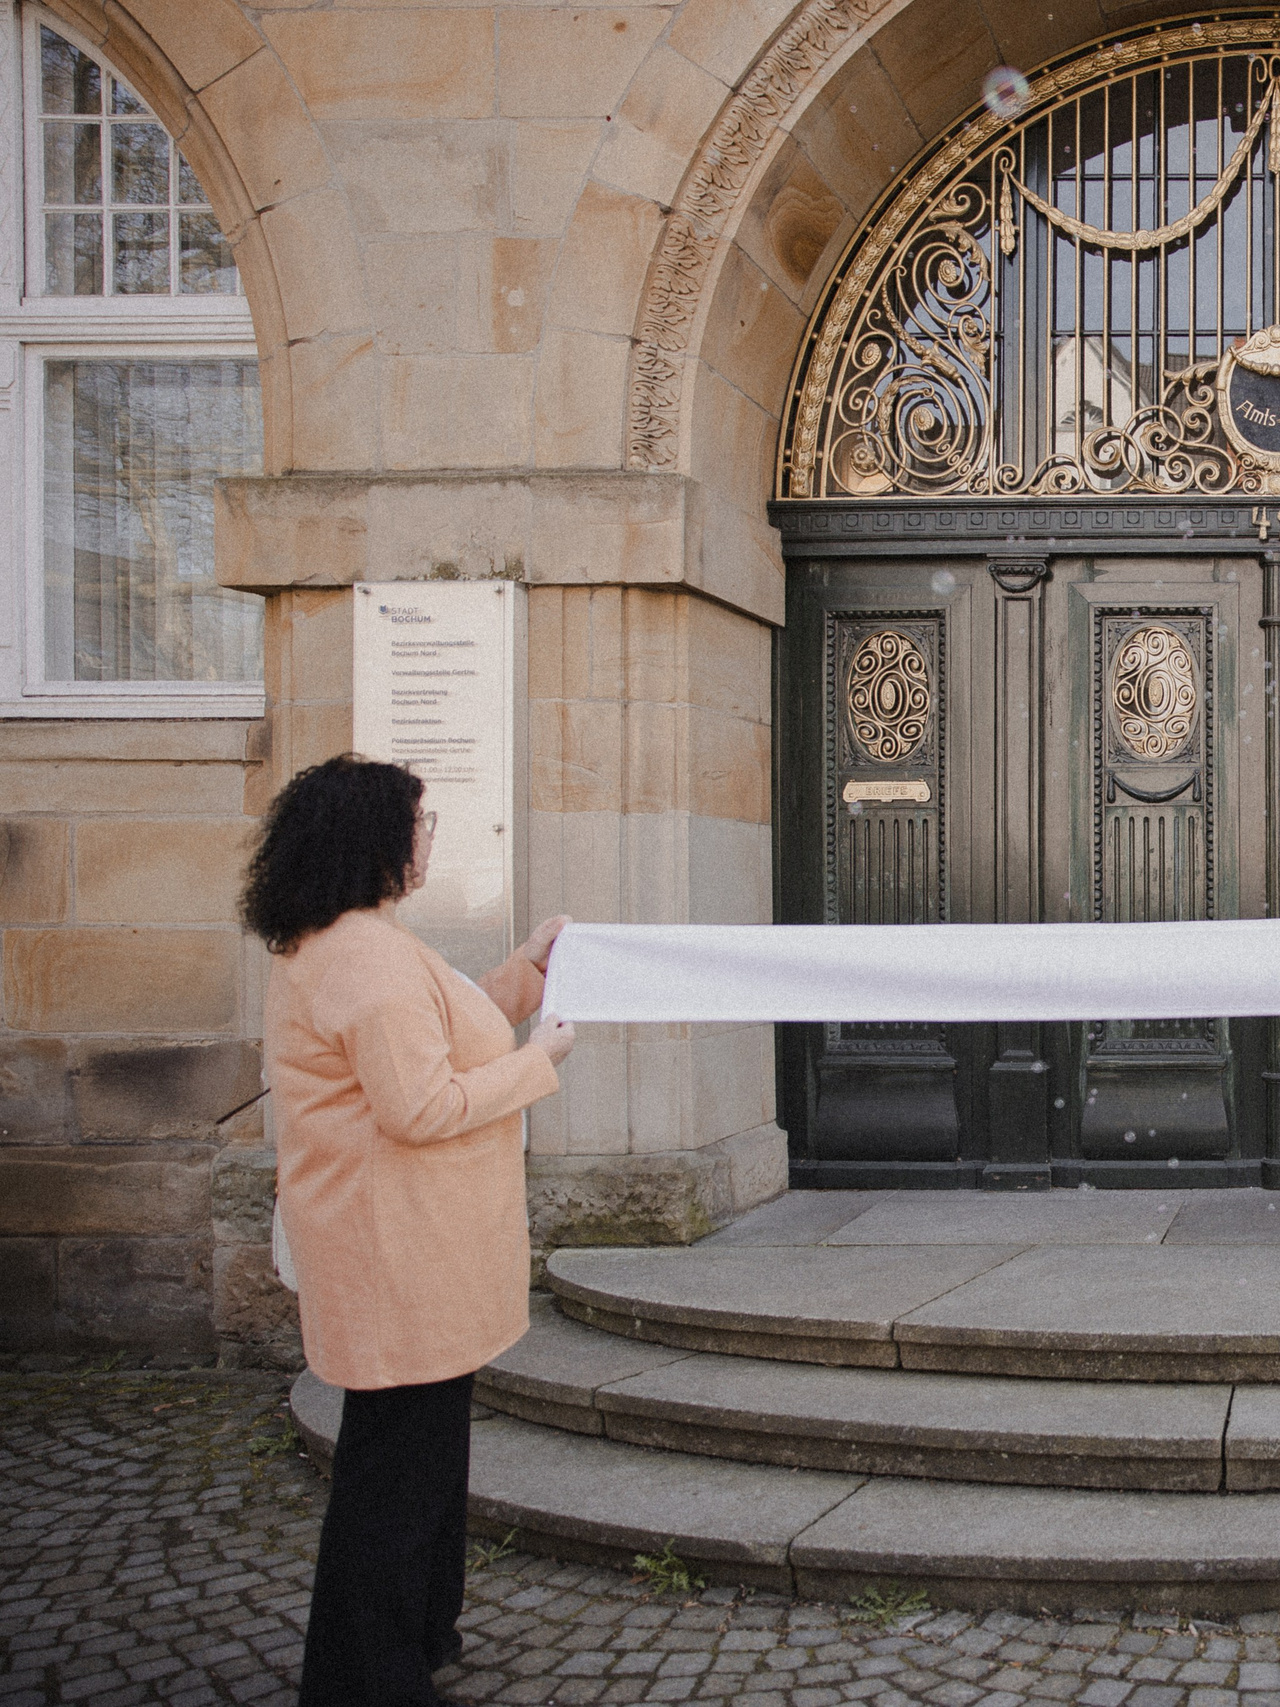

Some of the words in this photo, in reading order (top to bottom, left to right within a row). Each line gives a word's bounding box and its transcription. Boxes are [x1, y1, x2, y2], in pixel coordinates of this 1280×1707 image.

[391, 607, 419, 615] STADT
[391, 615, 432, 623] BOCHUM
[452, 669, 475, 677] Gerthe
